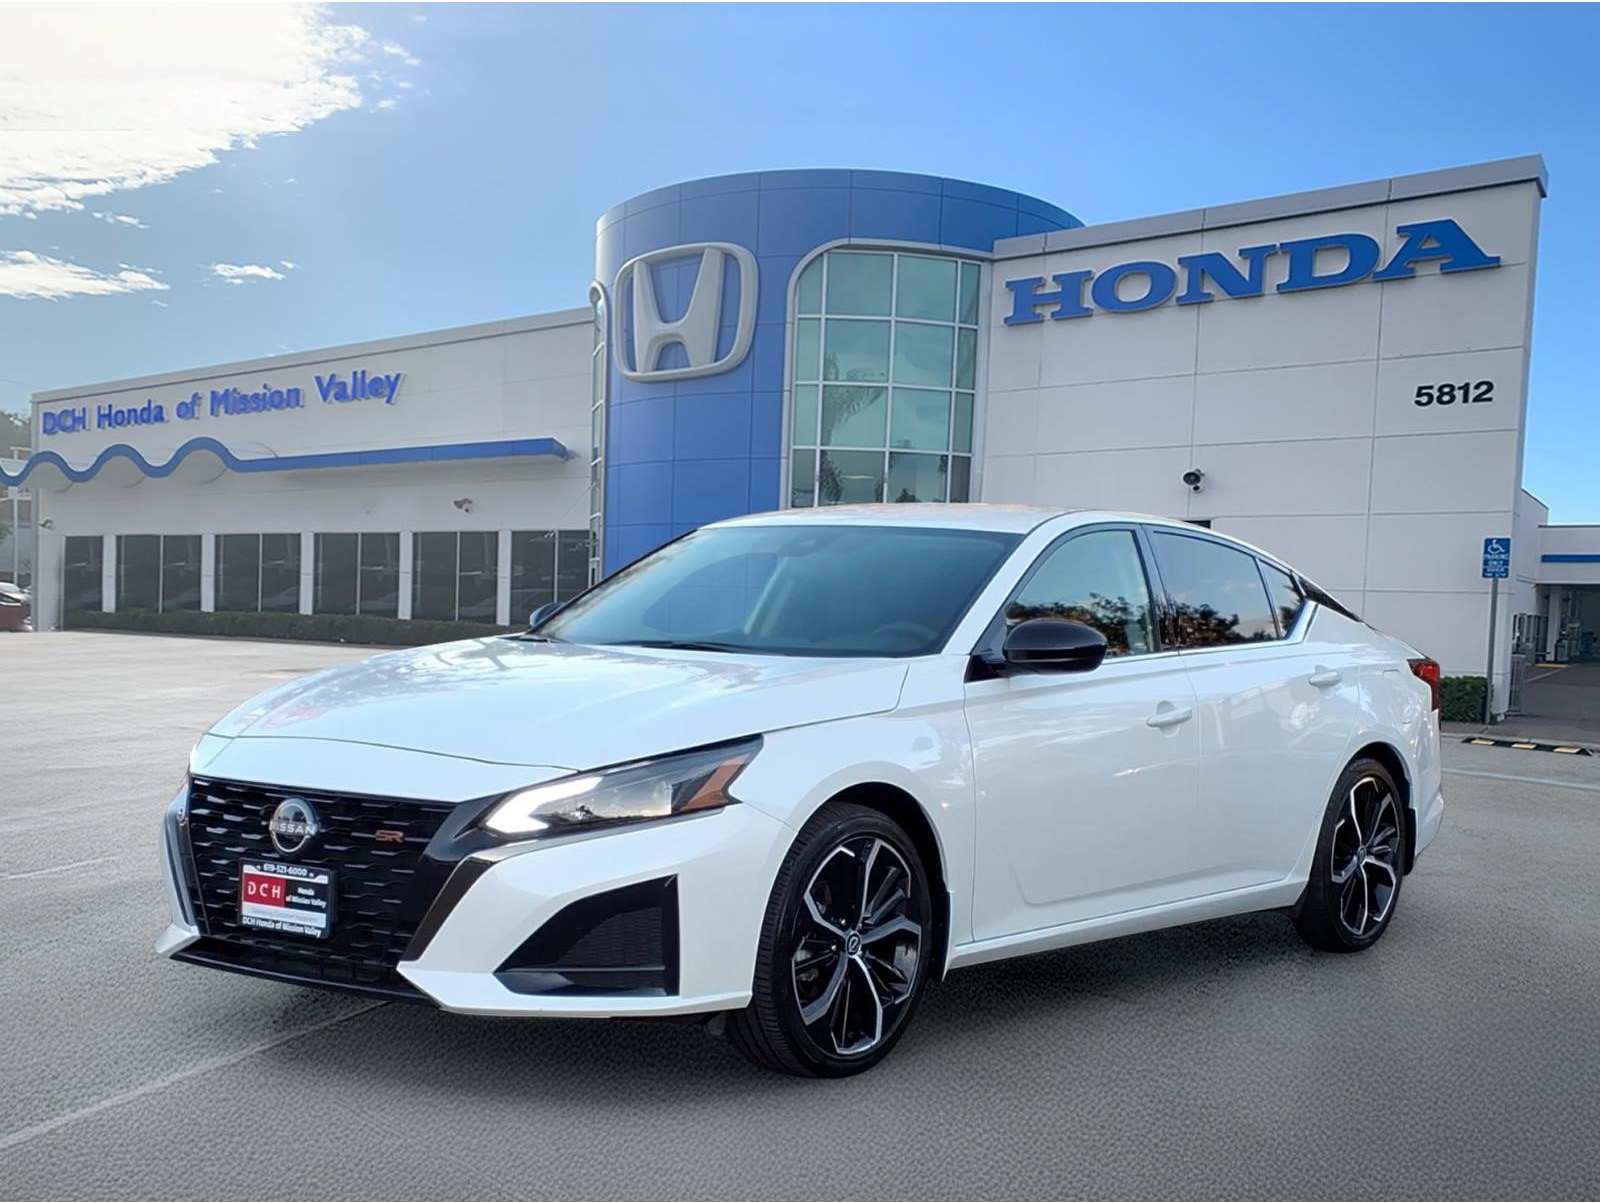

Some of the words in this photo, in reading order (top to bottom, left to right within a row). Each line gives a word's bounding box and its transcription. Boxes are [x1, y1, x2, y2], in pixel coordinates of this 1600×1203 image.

[1003, 218, 1502, 326] HONDA
[42, 407, 87, 436] DCH
[97, 399, 166, 429] Honda
[176, 391, 202, 421] of
[210, 383, 302, 417] Mission
[314, 370, 402, 405] Valley
[1414, 380, 1494, 407] 5812
